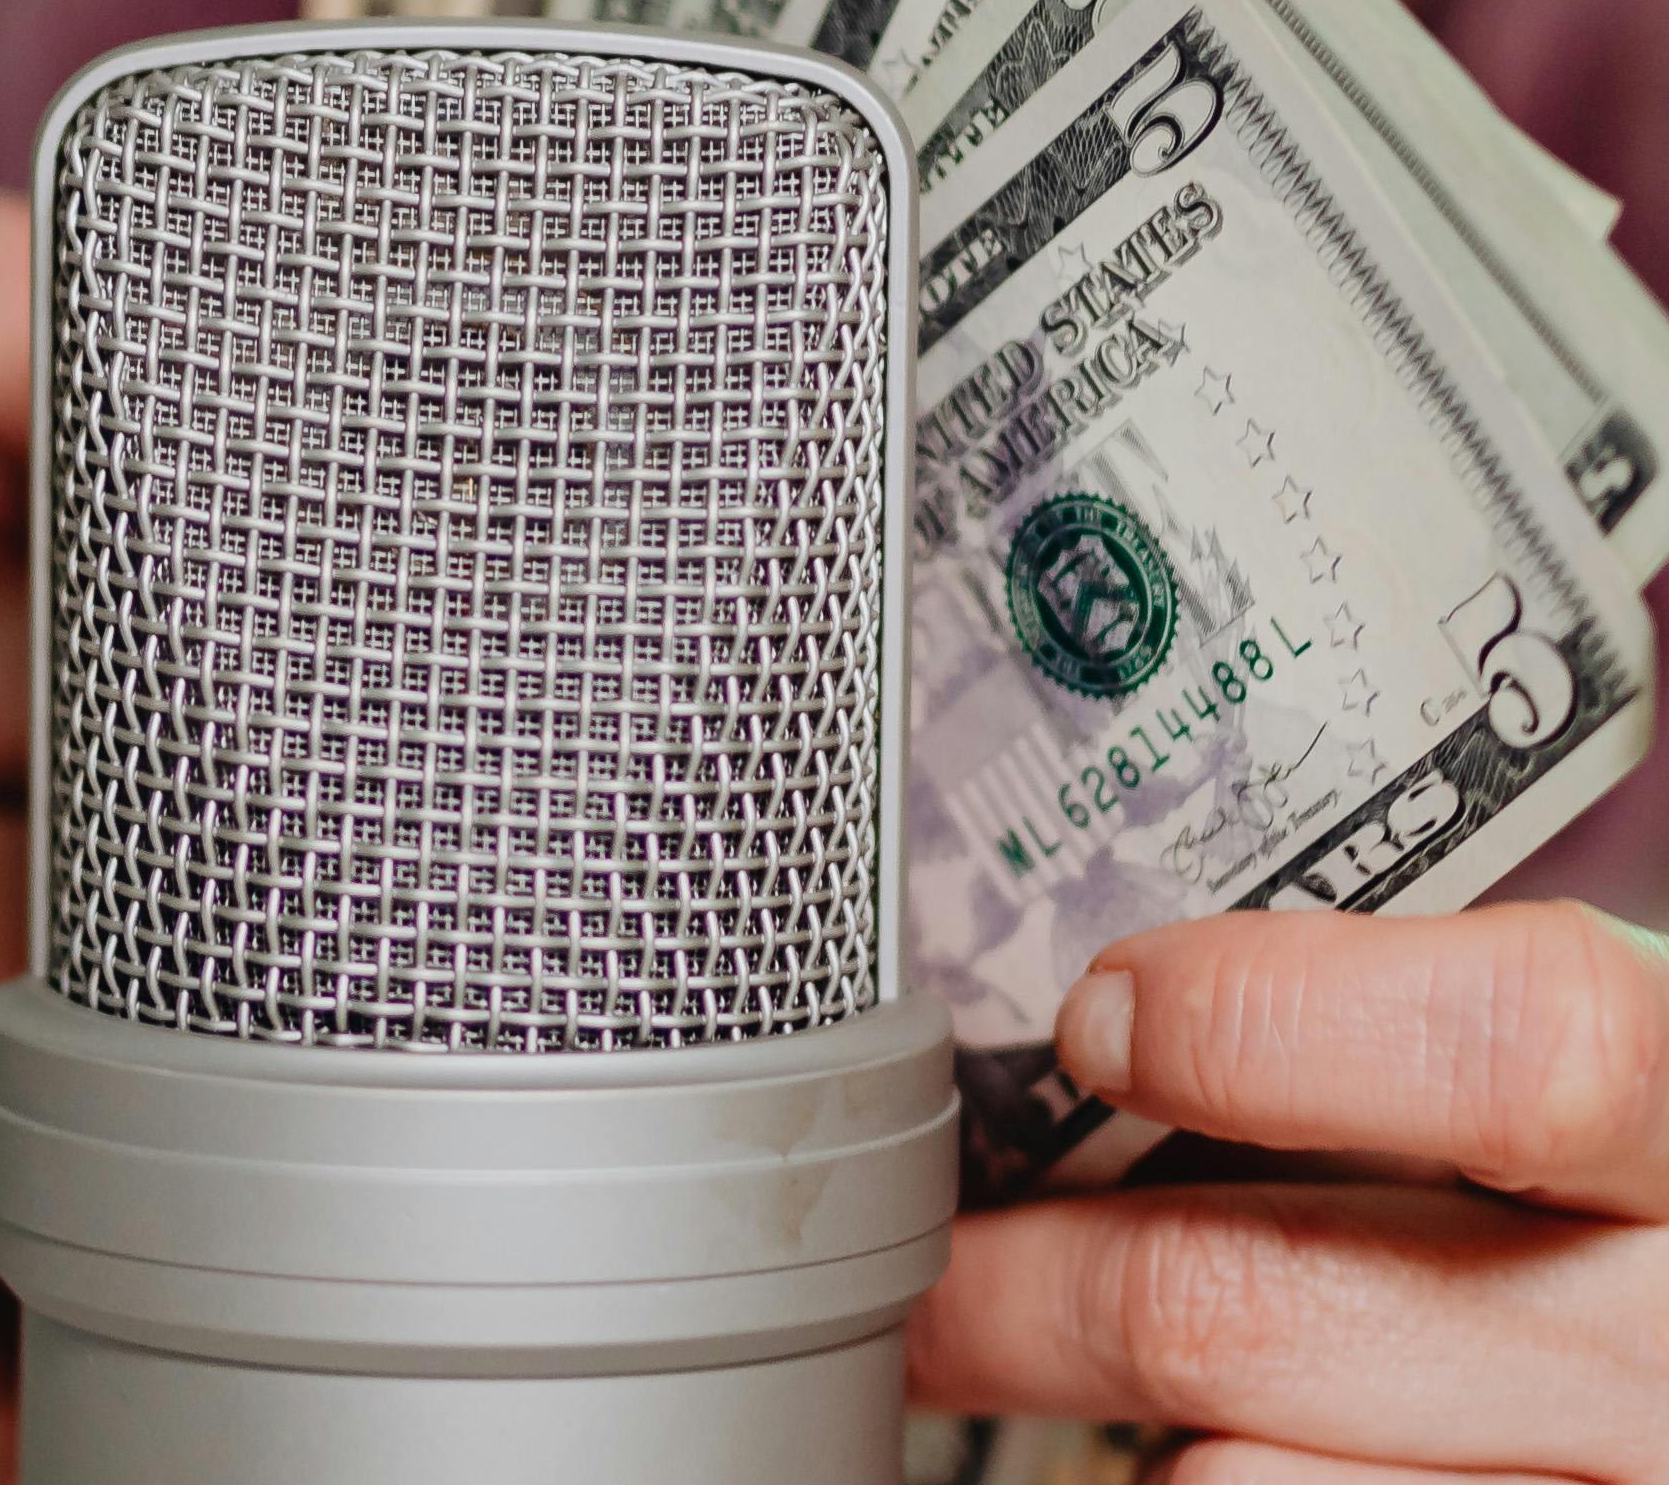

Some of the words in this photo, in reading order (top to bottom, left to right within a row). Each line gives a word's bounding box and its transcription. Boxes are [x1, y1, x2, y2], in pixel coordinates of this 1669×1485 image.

[1106, 40, 1225, 178] 5
[1041, 181, 1224, 356] STATES
[959, 315, 1184, 512] AMERICA
[1438, 571, 1576, 748] 5
